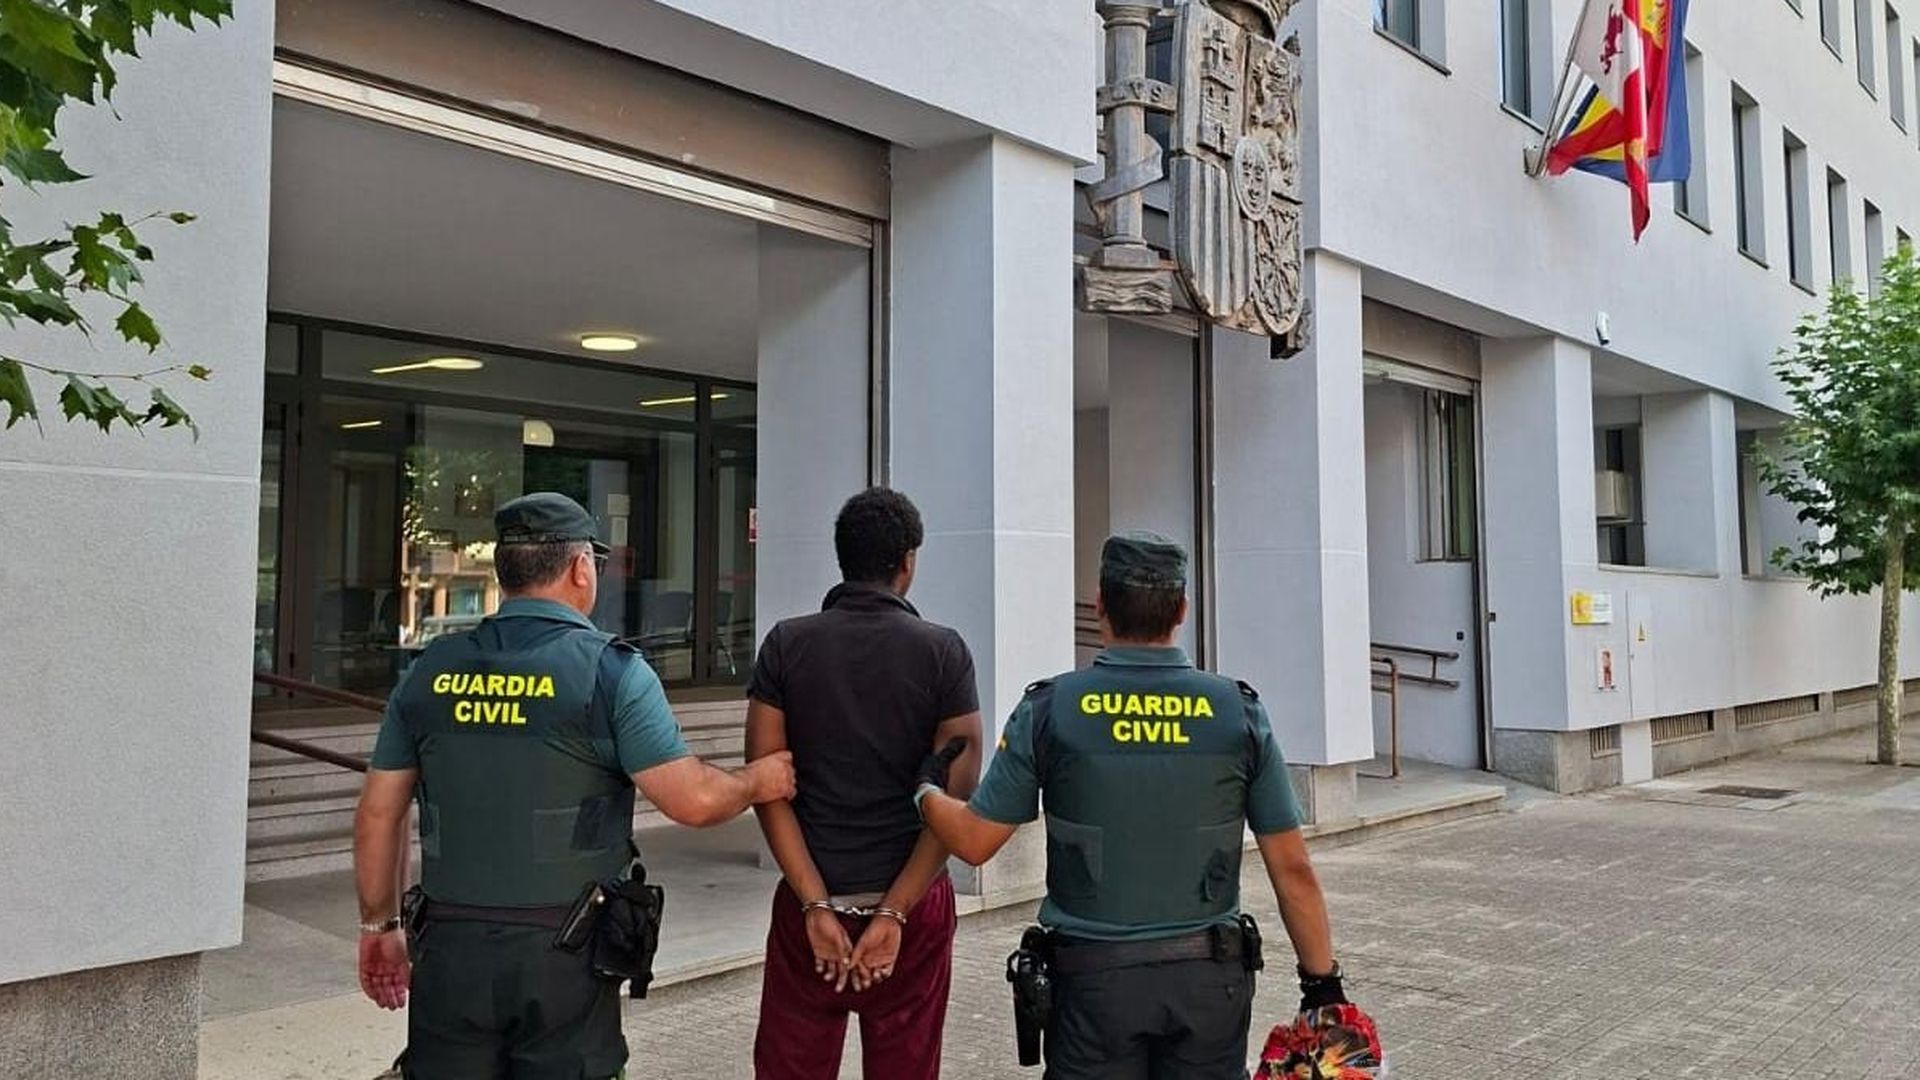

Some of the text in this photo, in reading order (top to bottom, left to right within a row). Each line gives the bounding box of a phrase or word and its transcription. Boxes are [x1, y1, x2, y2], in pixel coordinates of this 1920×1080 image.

[433, 673, 555, 697] GUARDIA
[454, 700, 527, 725] CIVIL
[1081, 693, 1214, 718] GUARDIA
[1111, 720, 1190, 744] CIVIL
